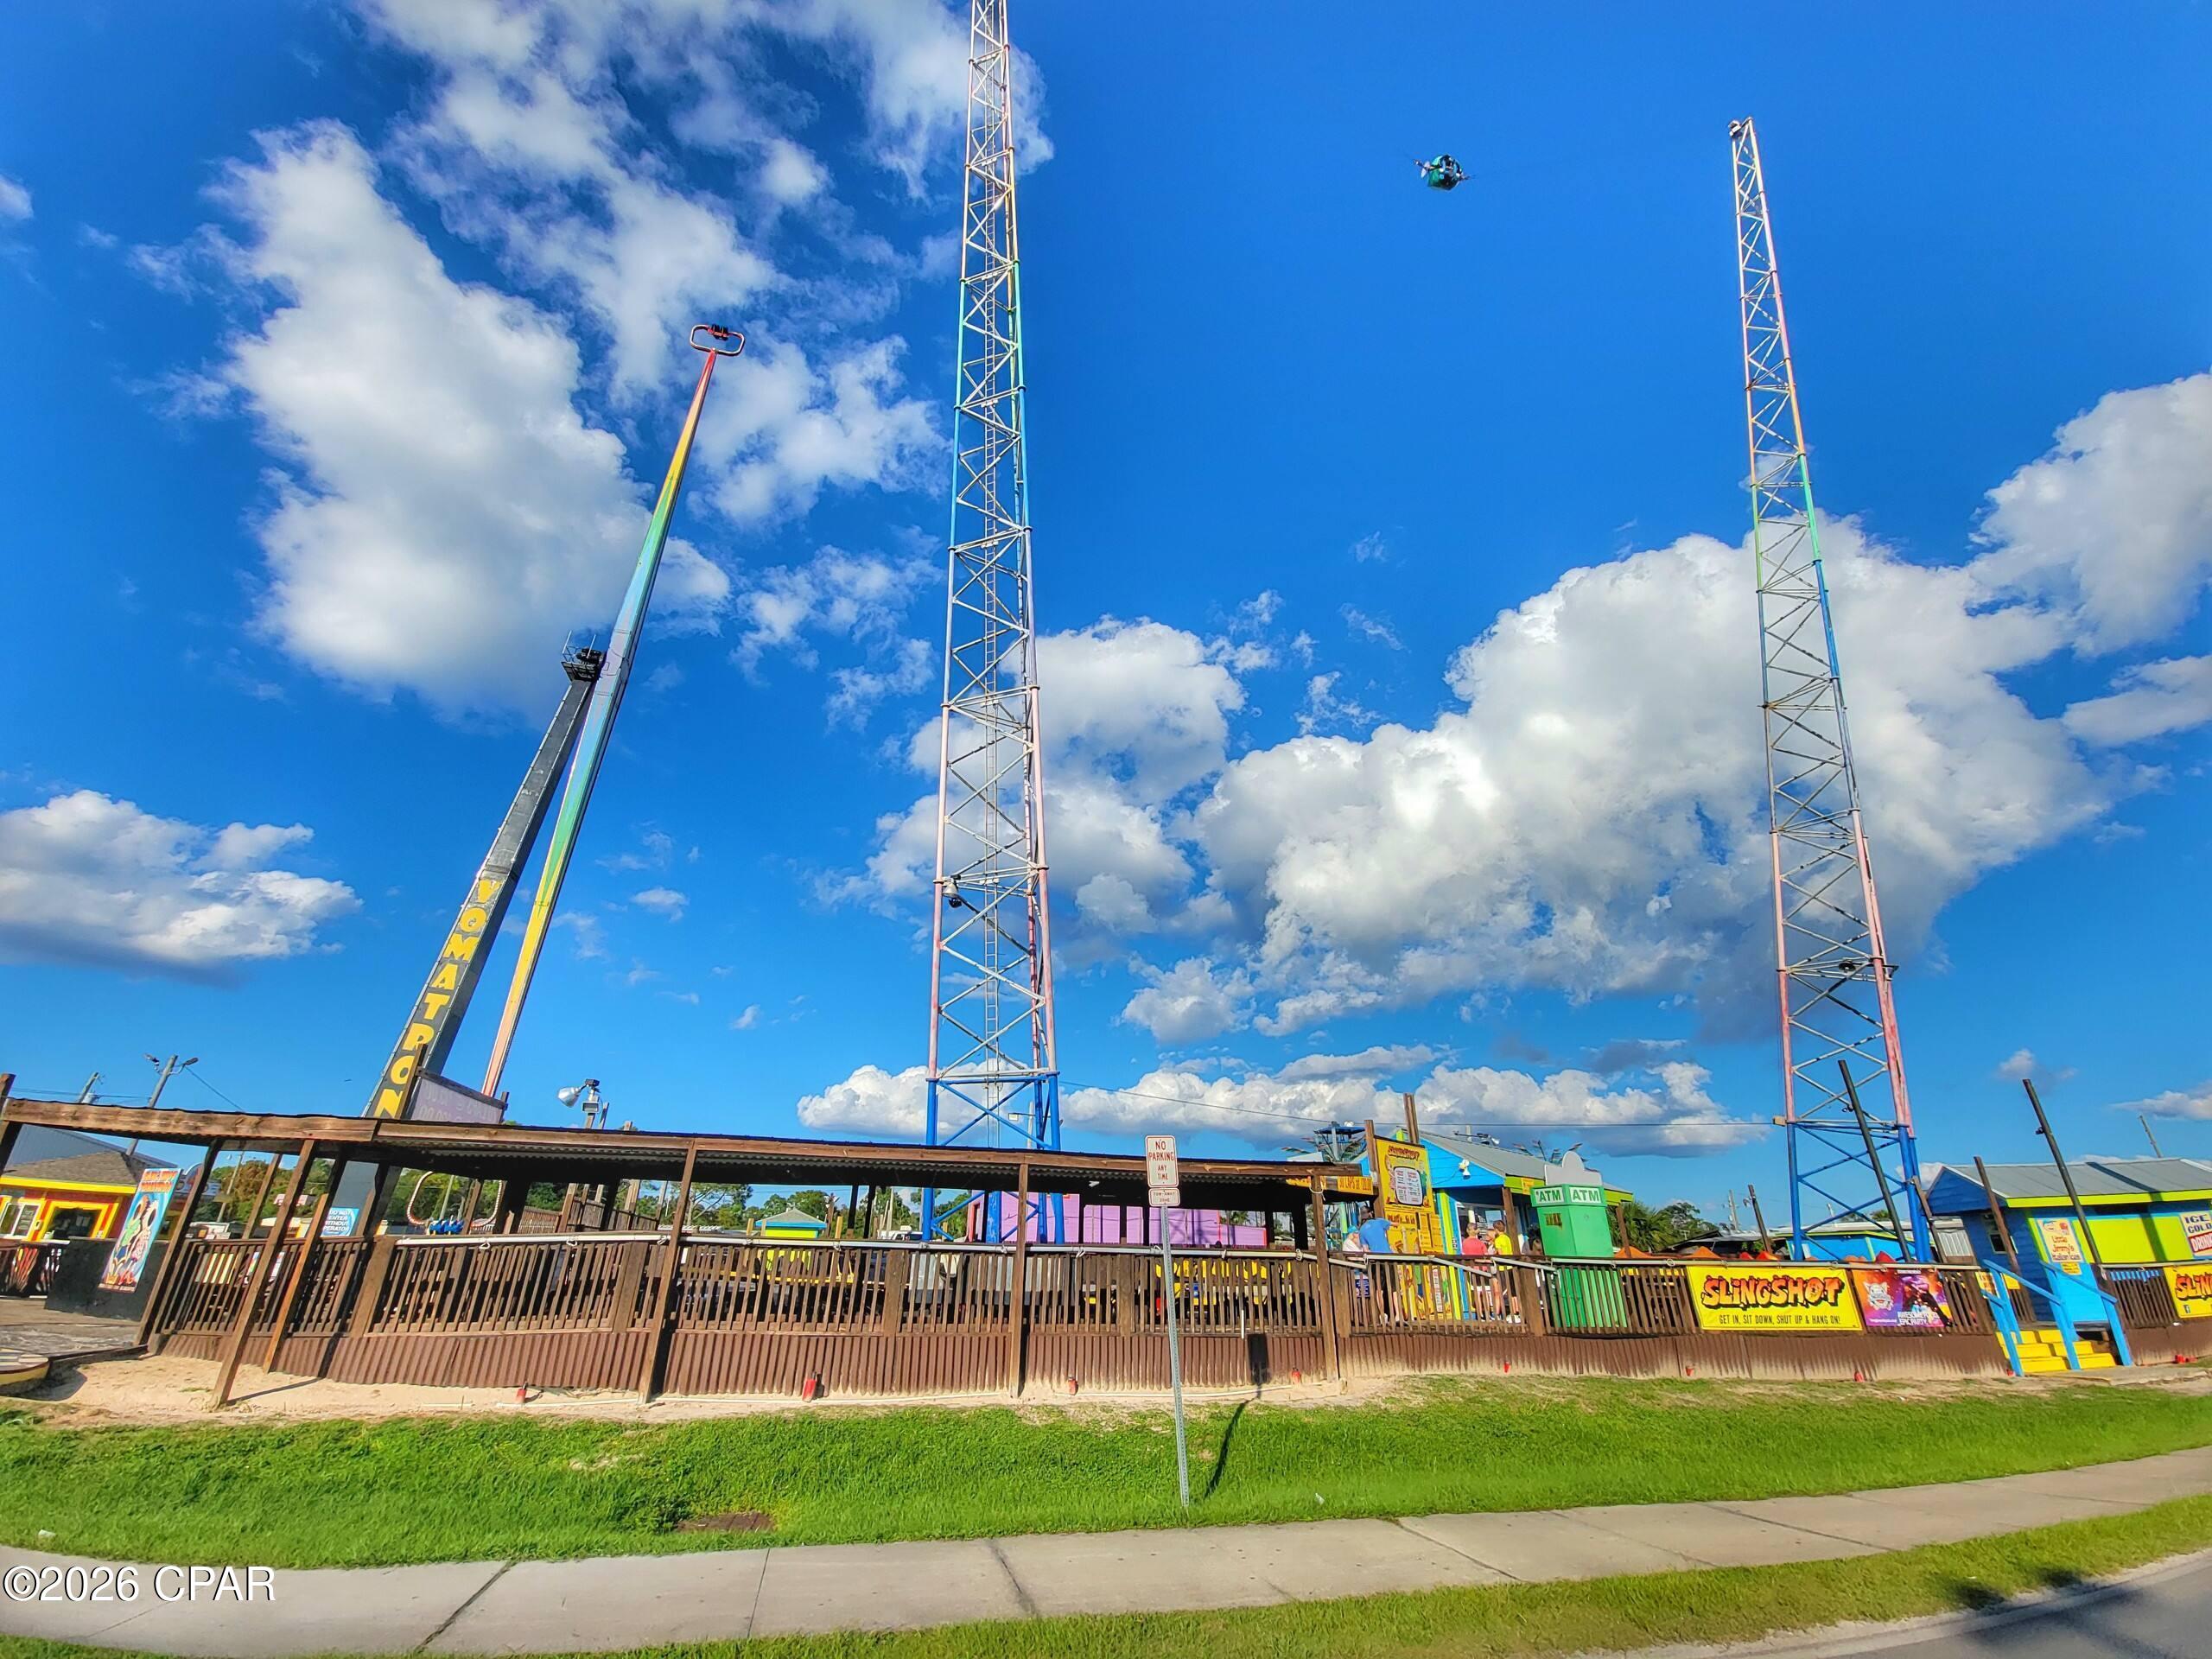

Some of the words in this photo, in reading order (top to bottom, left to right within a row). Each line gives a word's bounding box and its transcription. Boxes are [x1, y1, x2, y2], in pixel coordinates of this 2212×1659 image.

[373, 879, 501, 1118] VOMATRON
[1155, 1141, 1166, 1150] NO
[1148, 1152, 1174, 1161] PARKING
[1539, 1190, 1561, 1202] ATM
[1573, 1189, 1599, 1202] ATM
[2185, 1214, 2209, 1224] ICE
[2188, 1223, 2212, 1234] COLD
[2175, 1272, 2212, 1301] SLIN
[1719, 1314, 1729, 1324] GET
[1732, 1314, 1741, 1325] IN,
[1743, 1314, 1752, 1324] SIT
[1755, 1314, 1775, 1325] DOWN,
[1777, 1314, 1792, 1324] SHUT
[1795, 1314, 1802, 1324] UP
[1804, 1315, 1810, 1324] &
[1812, 1314, 1828, 1324] HANG
[1830, 1314, 1840, 1324] ON!
